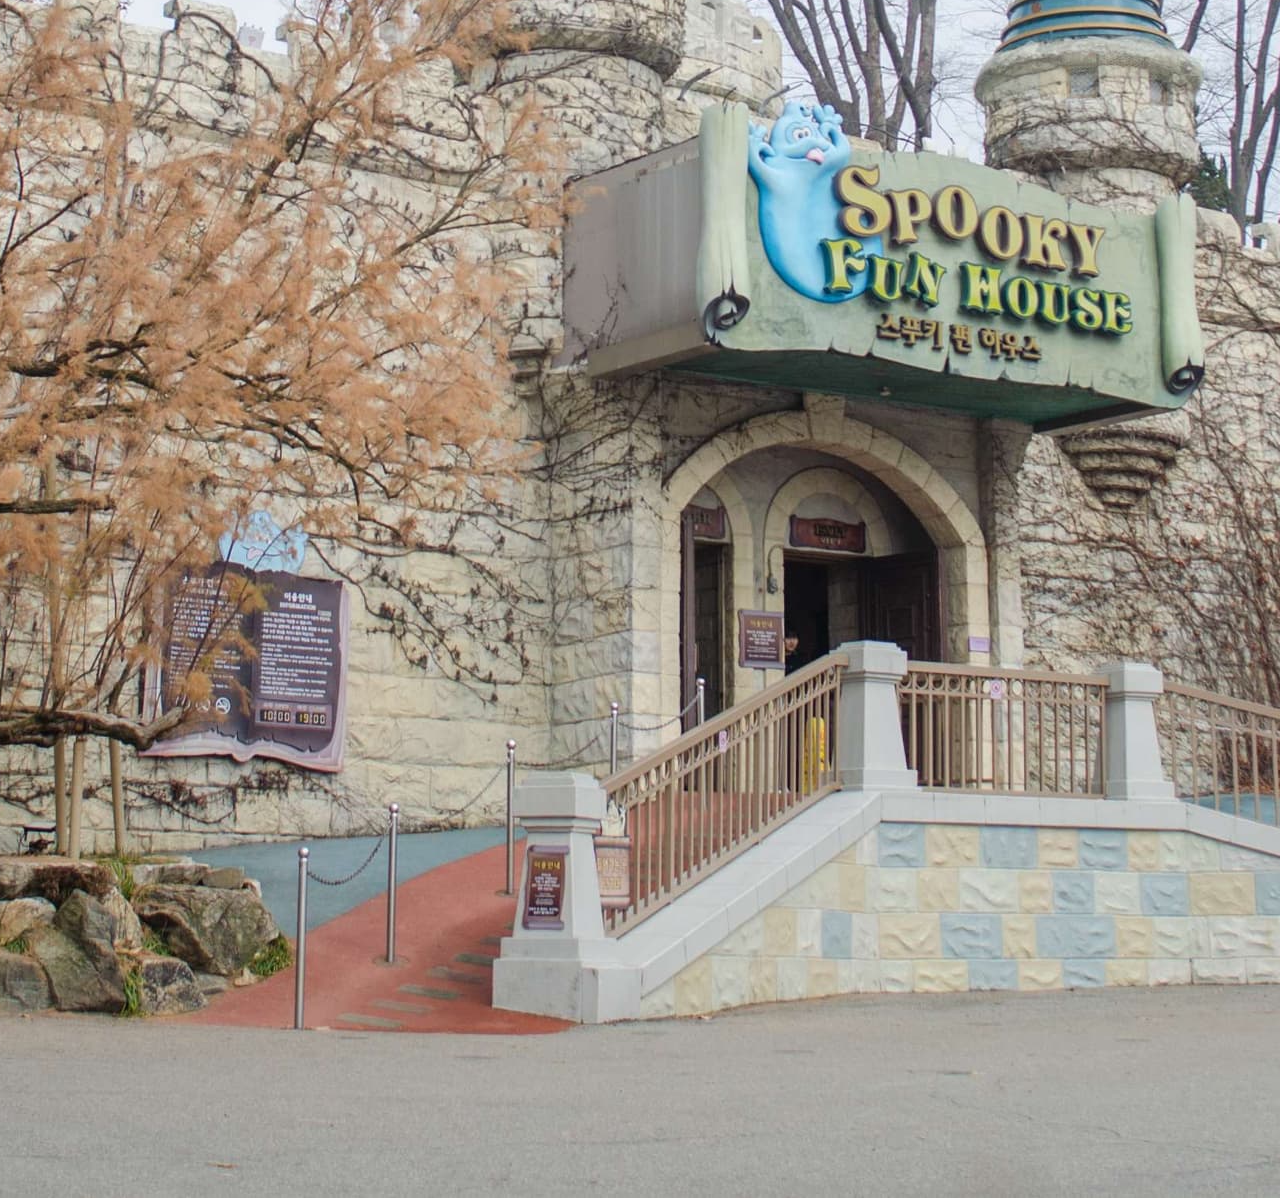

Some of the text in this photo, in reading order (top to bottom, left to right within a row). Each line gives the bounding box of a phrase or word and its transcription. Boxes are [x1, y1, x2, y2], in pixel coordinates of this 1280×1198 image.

[819, 237, 1134, 335] FUN HOUSE
[877, 313, 944, 349] 스푸키
[979, 327, 1043, 359] 하우스
[264, 710, 290, 722] 10:00
